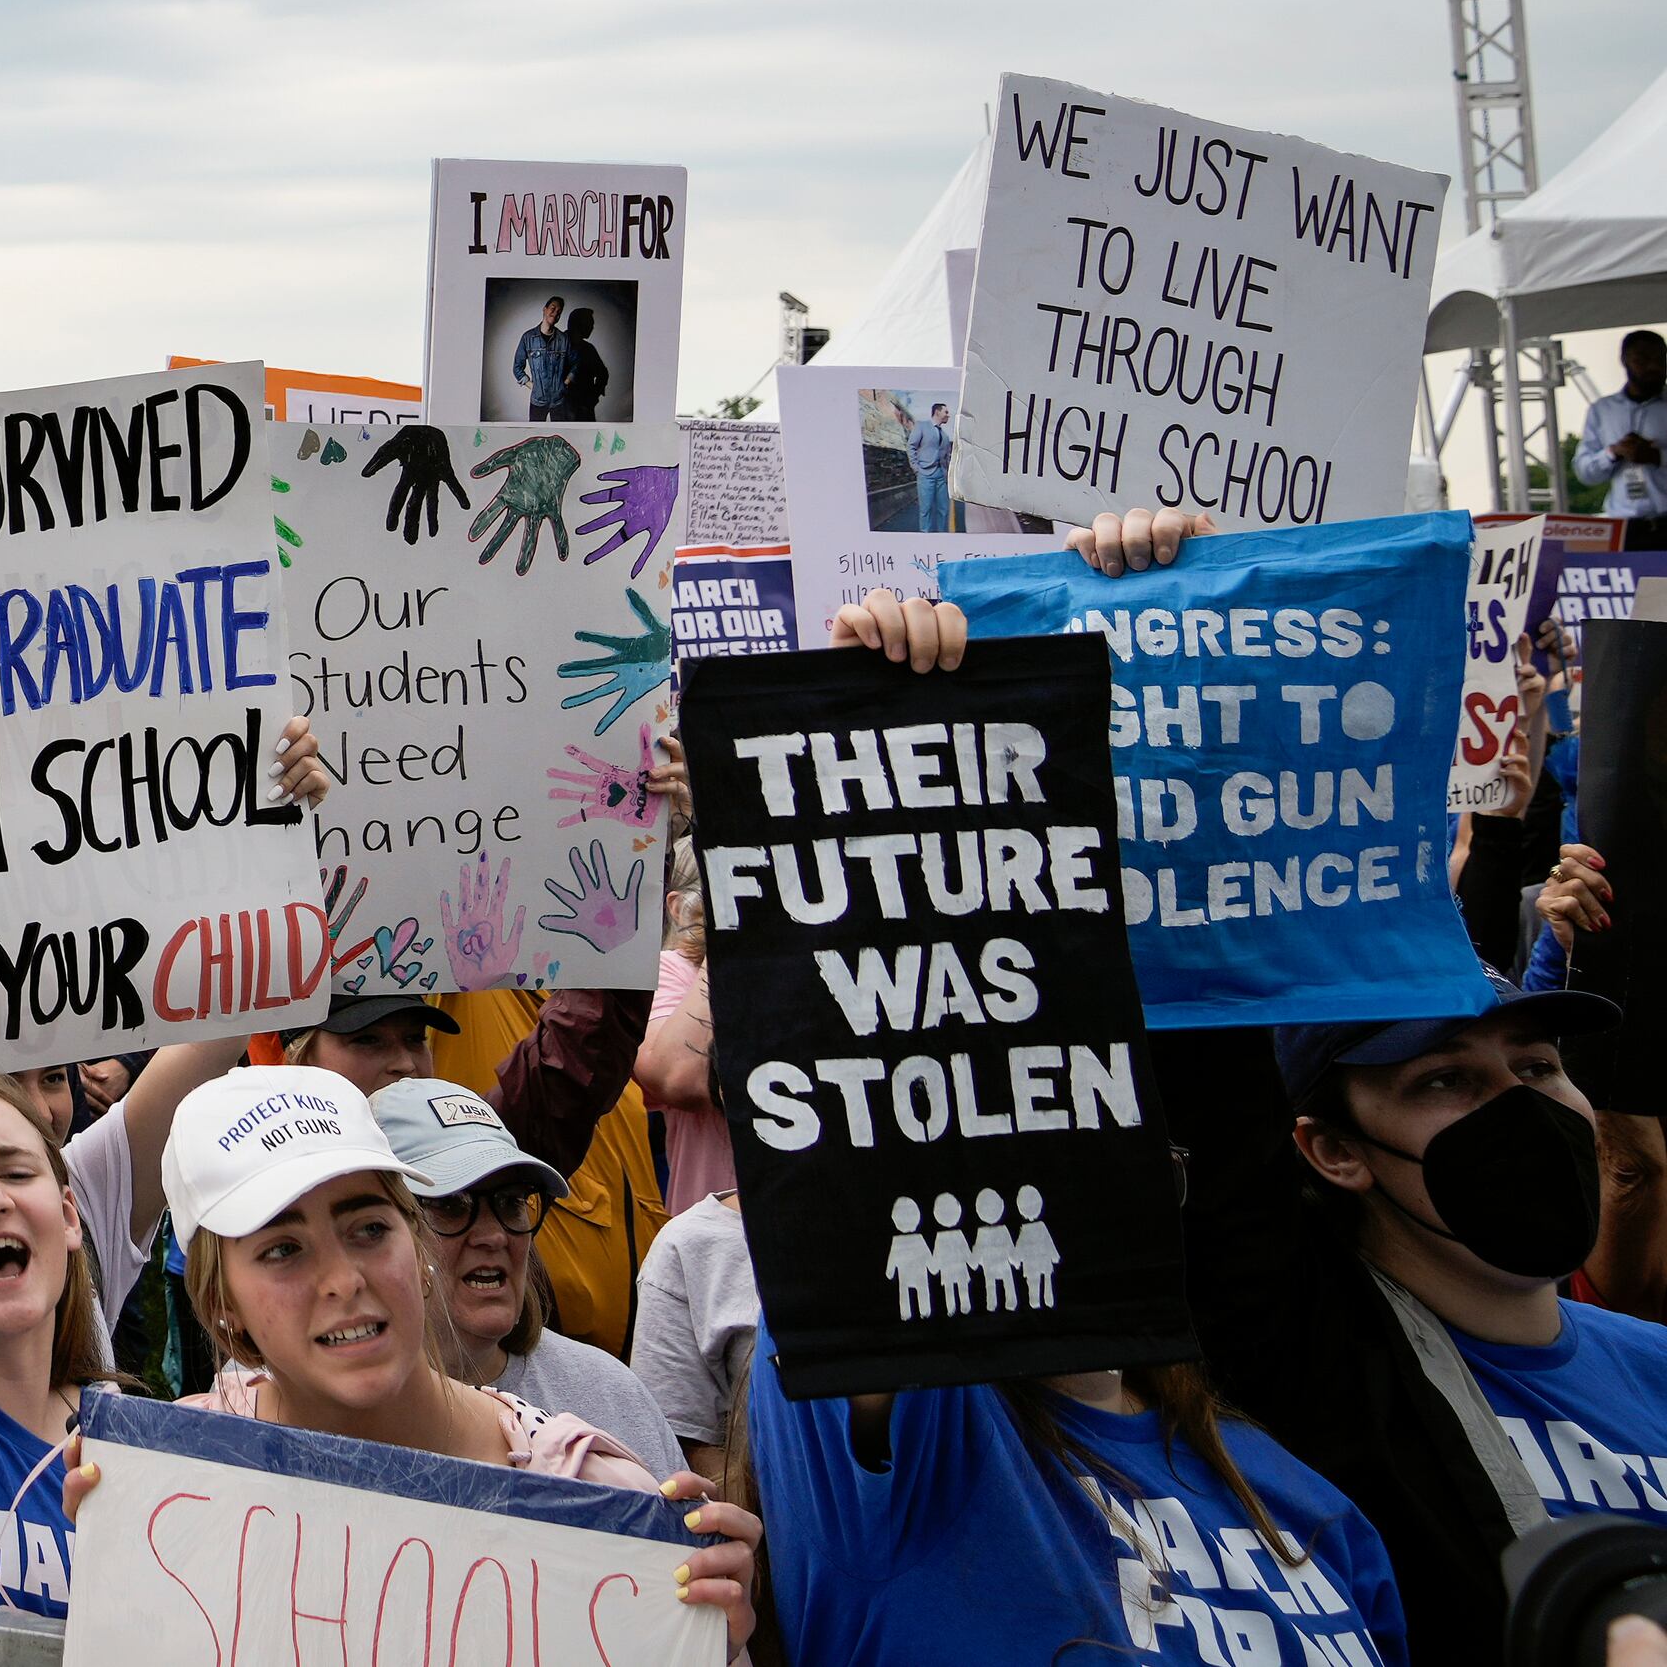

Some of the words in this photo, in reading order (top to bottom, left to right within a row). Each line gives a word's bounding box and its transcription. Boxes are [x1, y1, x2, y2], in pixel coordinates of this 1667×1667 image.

[1012, 92, 1106, 180] WE
[1134, 127, 1267, 221] JUST
[1292, 166, 1434, 279] WANT
[468, 193, 488, 255] I
[495, 189, 617, 259] MARCH
[619, 193, 673, 261] FOR
[1067, 217, 1134, 296] TO
[1161, 241, 1278, 333] LIVE
[1037, 303, 1284, 427] THROUGH
[1003, 391, 1129, 494] HIGH
[837, 551, 895, 576] 5/19/14
[314, 576, 450, 641] Our
[721, 607, 787, 639] OUR
[289, 649, 529, 715] Students
[1280, 681, 1396, 746] TO
[30, 707, 304, 865] SCHOOL
[734, 722, 1046, 817] THEIR
[1220, 763, 1395, 837] GUN
[314, 805, 522, 860] hange
[704, 826, 1110, 931] FUTURE
[153, 901, 330, 1023] CHILD
[813, 938, 1040, 1037] WAS
[217, 1092, 291, 1152] PROTECT
[297, 1092, 340, 1116] KIDS
[459, 1103, 492, 1120] USA
[746, 1042, 1144, 1152] STOLEN
[259, 1123, 294, 1152] NOT
[296, 1118, 342, 1136] GUNS
